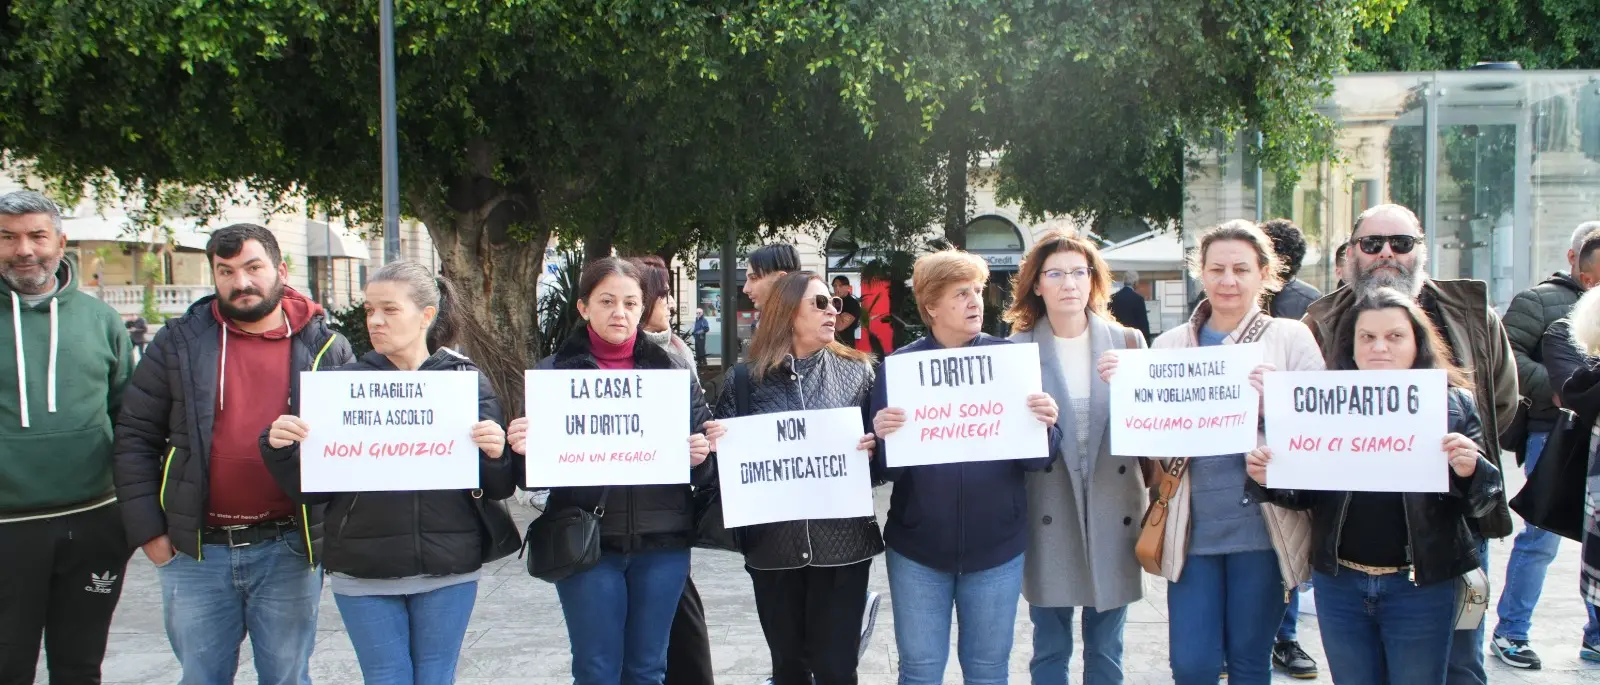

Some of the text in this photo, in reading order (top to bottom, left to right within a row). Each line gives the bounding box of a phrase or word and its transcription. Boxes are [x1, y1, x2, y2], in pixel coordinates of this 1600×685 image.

[985, 256, 1012, 264] iCredit
[918, 355, 993, 387] I DIRITTI
[1149, 361, 1225, 379] QUESTO NATALE
[351, 383, 425, 398] LA FRAGILITA'
[571, 375, 642, 399] LA CASA È
[1135, 385, 1240, 403] NON VOGLIAMO REGALI
[1294, 385, 1419, 416] COMPARTO 6
[343, 409, 433, 426] MERITA ASCOLTO
[914, 400, 1003, 421] NON SONO
[566, 414, 643, 437] UN DIRITTO,
[777, 418, 806, 442] NON
[921, 418, 1000, 442] PRIVILEGI!
[1126, 412, 1246, 431] VOGLIAMO DIRITTI!
[324, 440, 454, 459] NON GIUDIZIO!
[1289, 435, 1415, 452] NOI CI SIAMO!
[559, 448, 656, 463] NON UN REGALO!
[741, 454, 847, 484] DIMENTICATECI!
